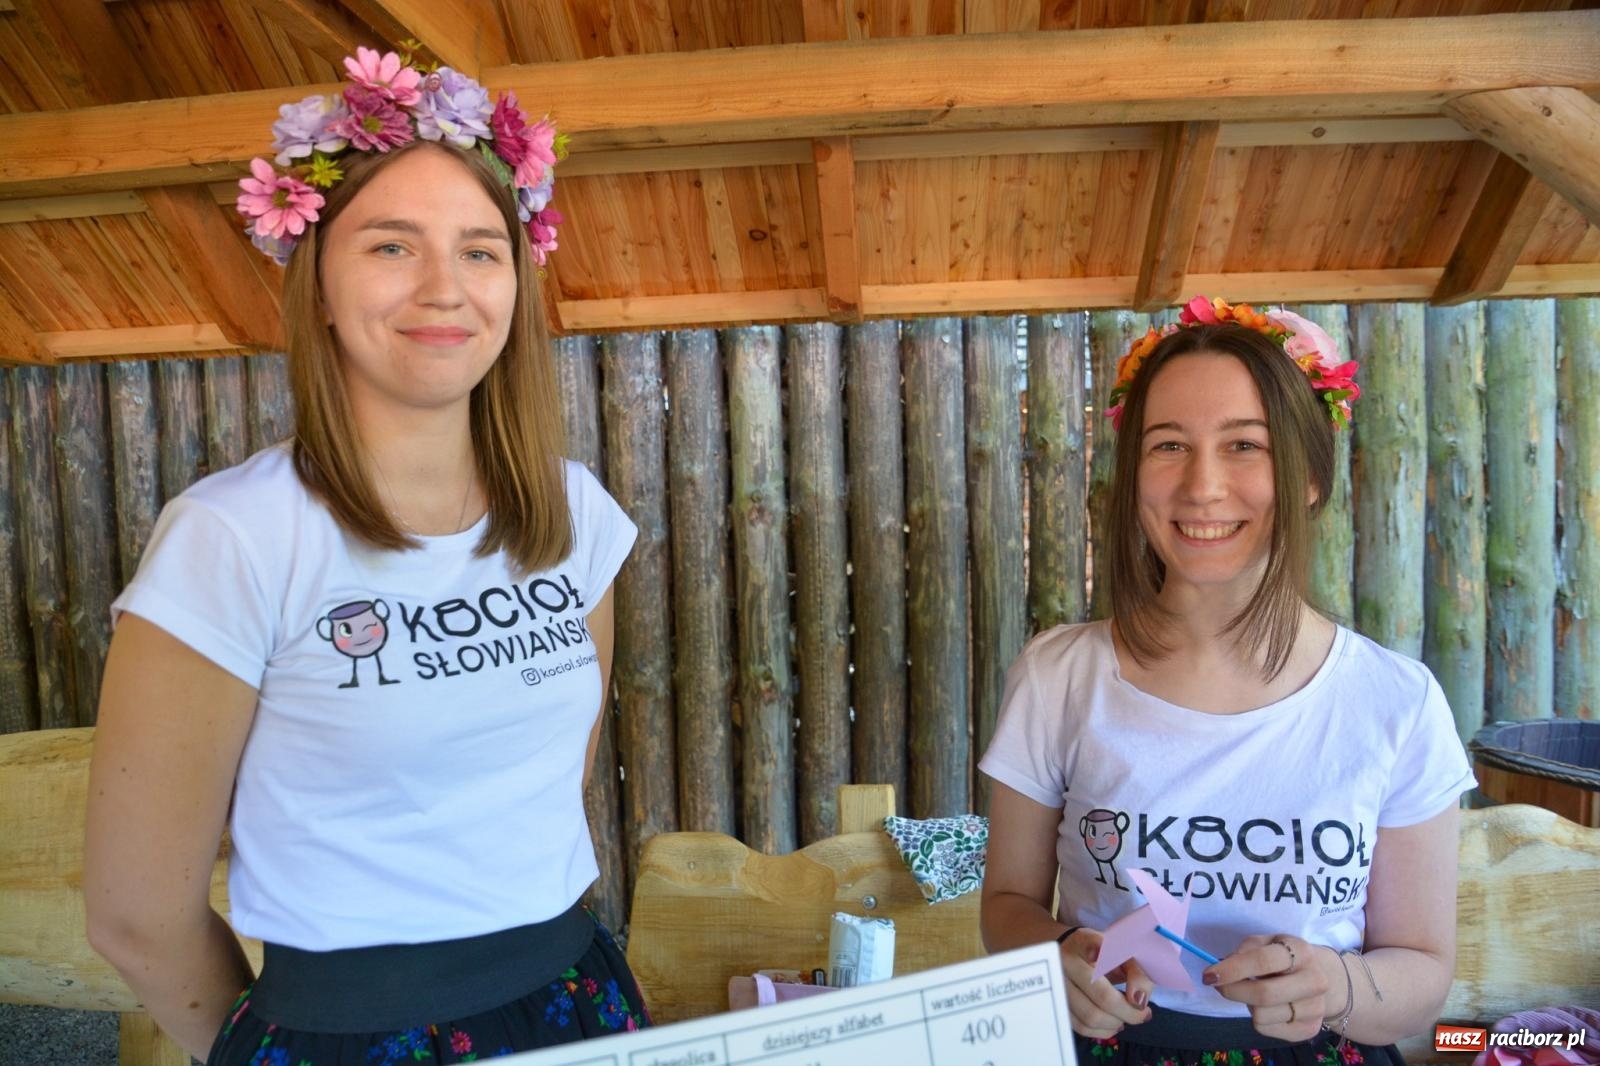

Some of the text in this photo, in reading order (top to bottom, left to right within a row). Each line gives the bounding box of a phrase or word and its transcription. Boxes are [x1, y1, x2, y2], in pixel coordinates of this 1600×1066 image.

[397, 574, 585, 643] KOCIOŁ
[1137, 813, 1370, 867] KOCIOŁ
[931, 974, 1044, 1010] wartość liczbowa
[837, 1012, 884, 1034] alfabet
[961, 1014, 1006, 1045] 400
